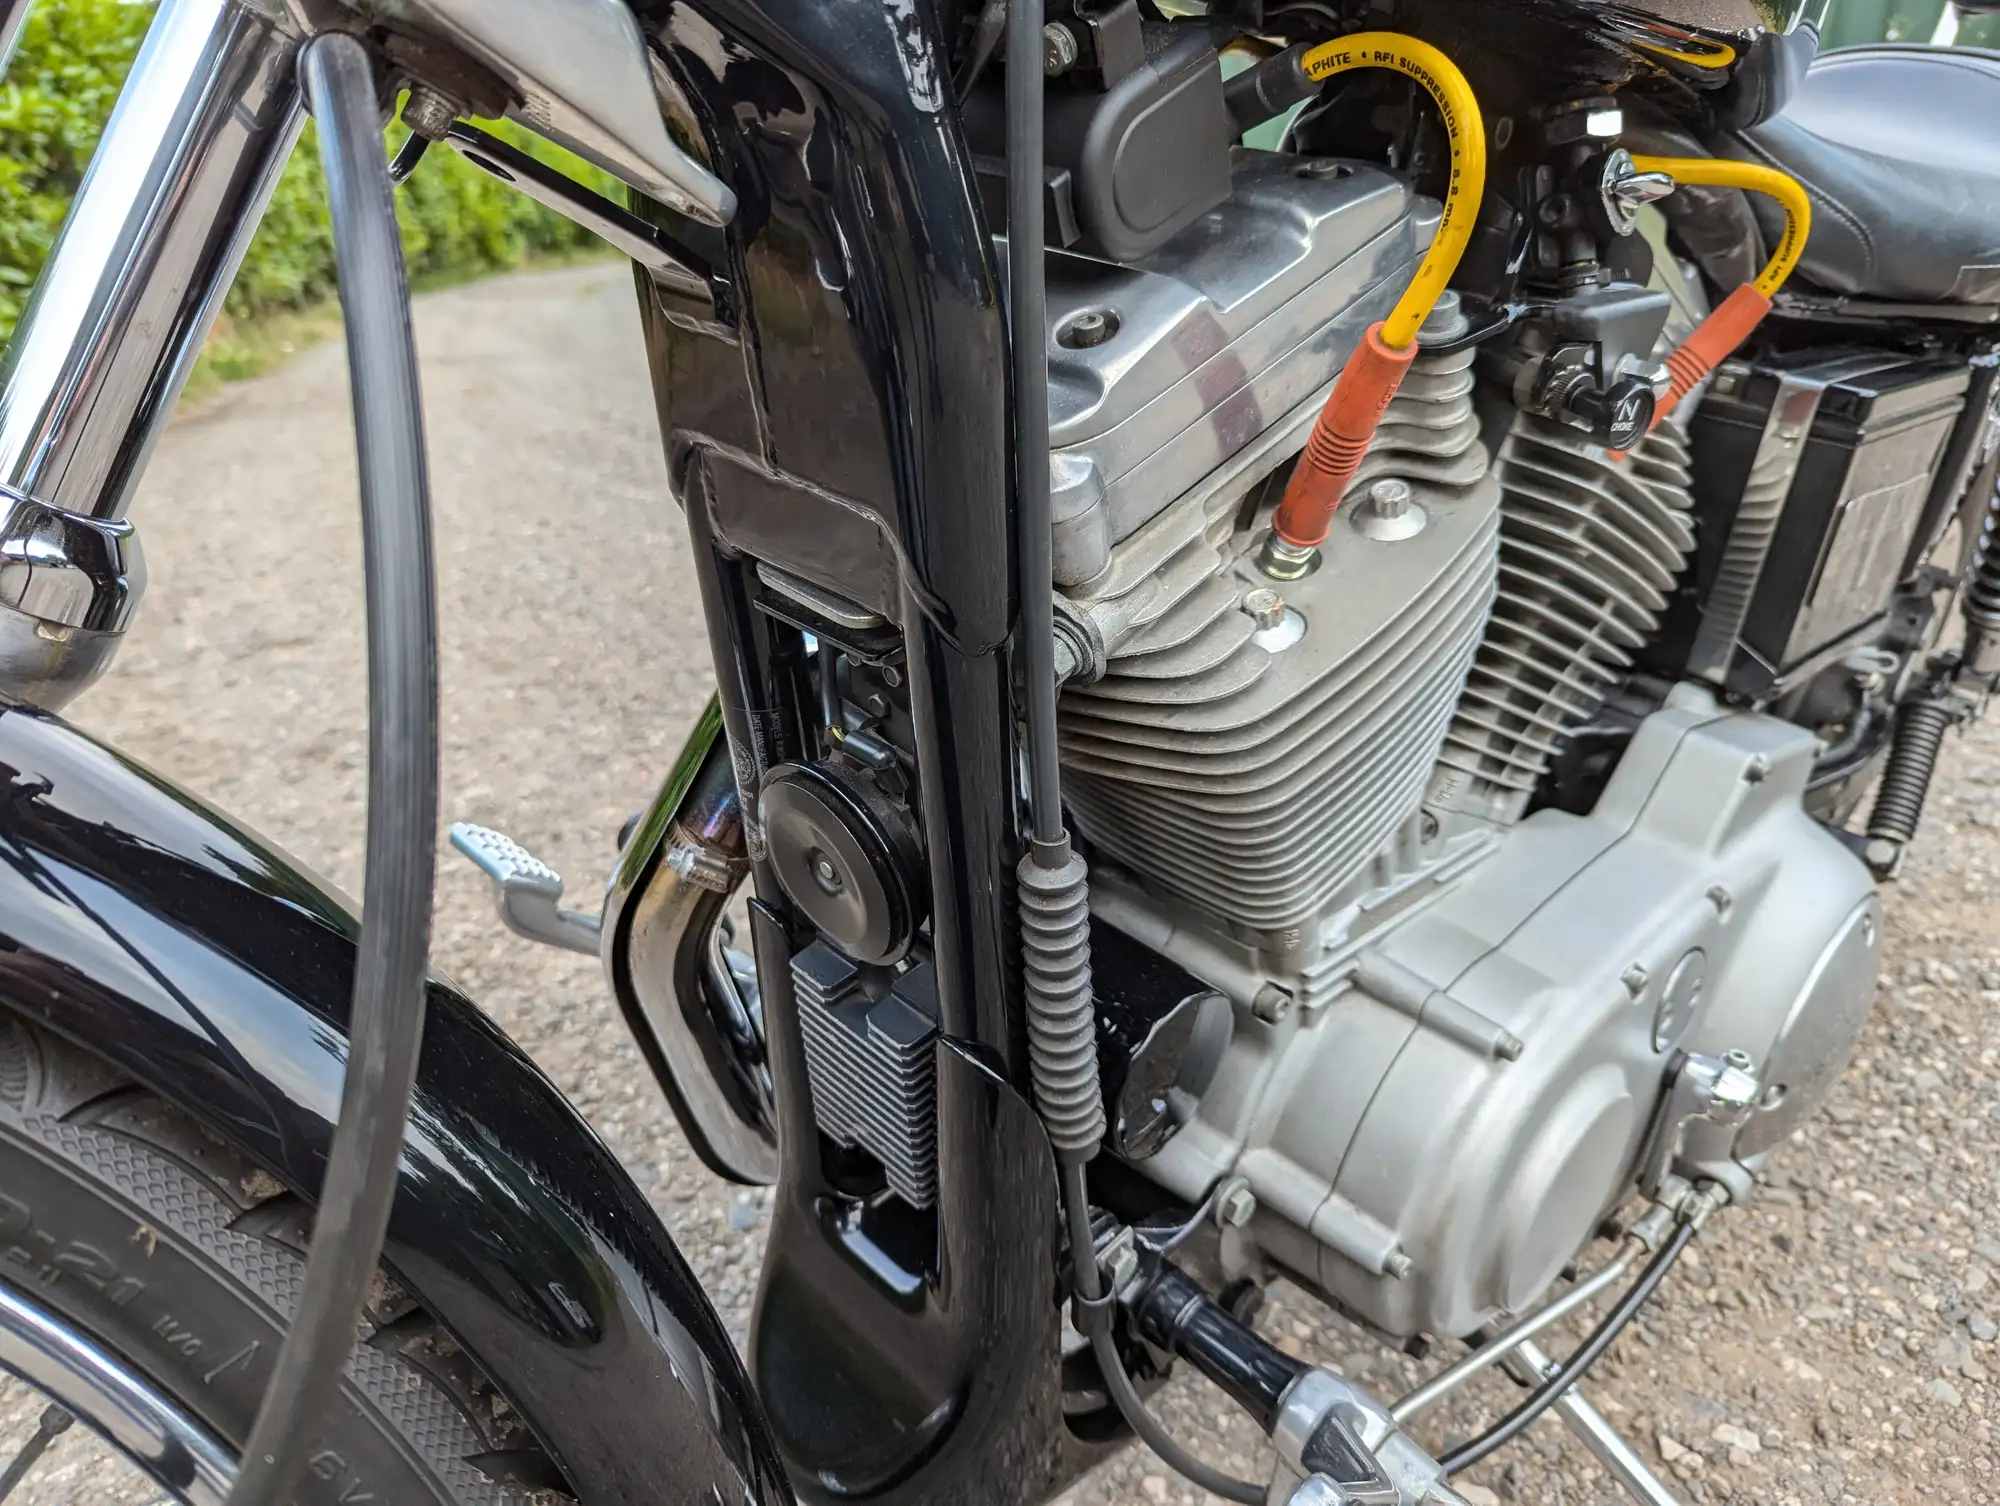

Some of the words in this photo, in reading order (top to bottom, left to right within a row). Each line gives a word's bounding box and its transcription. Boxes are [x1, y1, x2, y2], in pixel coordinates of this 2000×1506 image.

[1374, 50, 1394, 64] RFI
[1399, 57, 1458, 139] SUPPRESSION
[1451, 168, 1460, 196] 8.8
[1610, 421, 1635, 432] CHOKE
